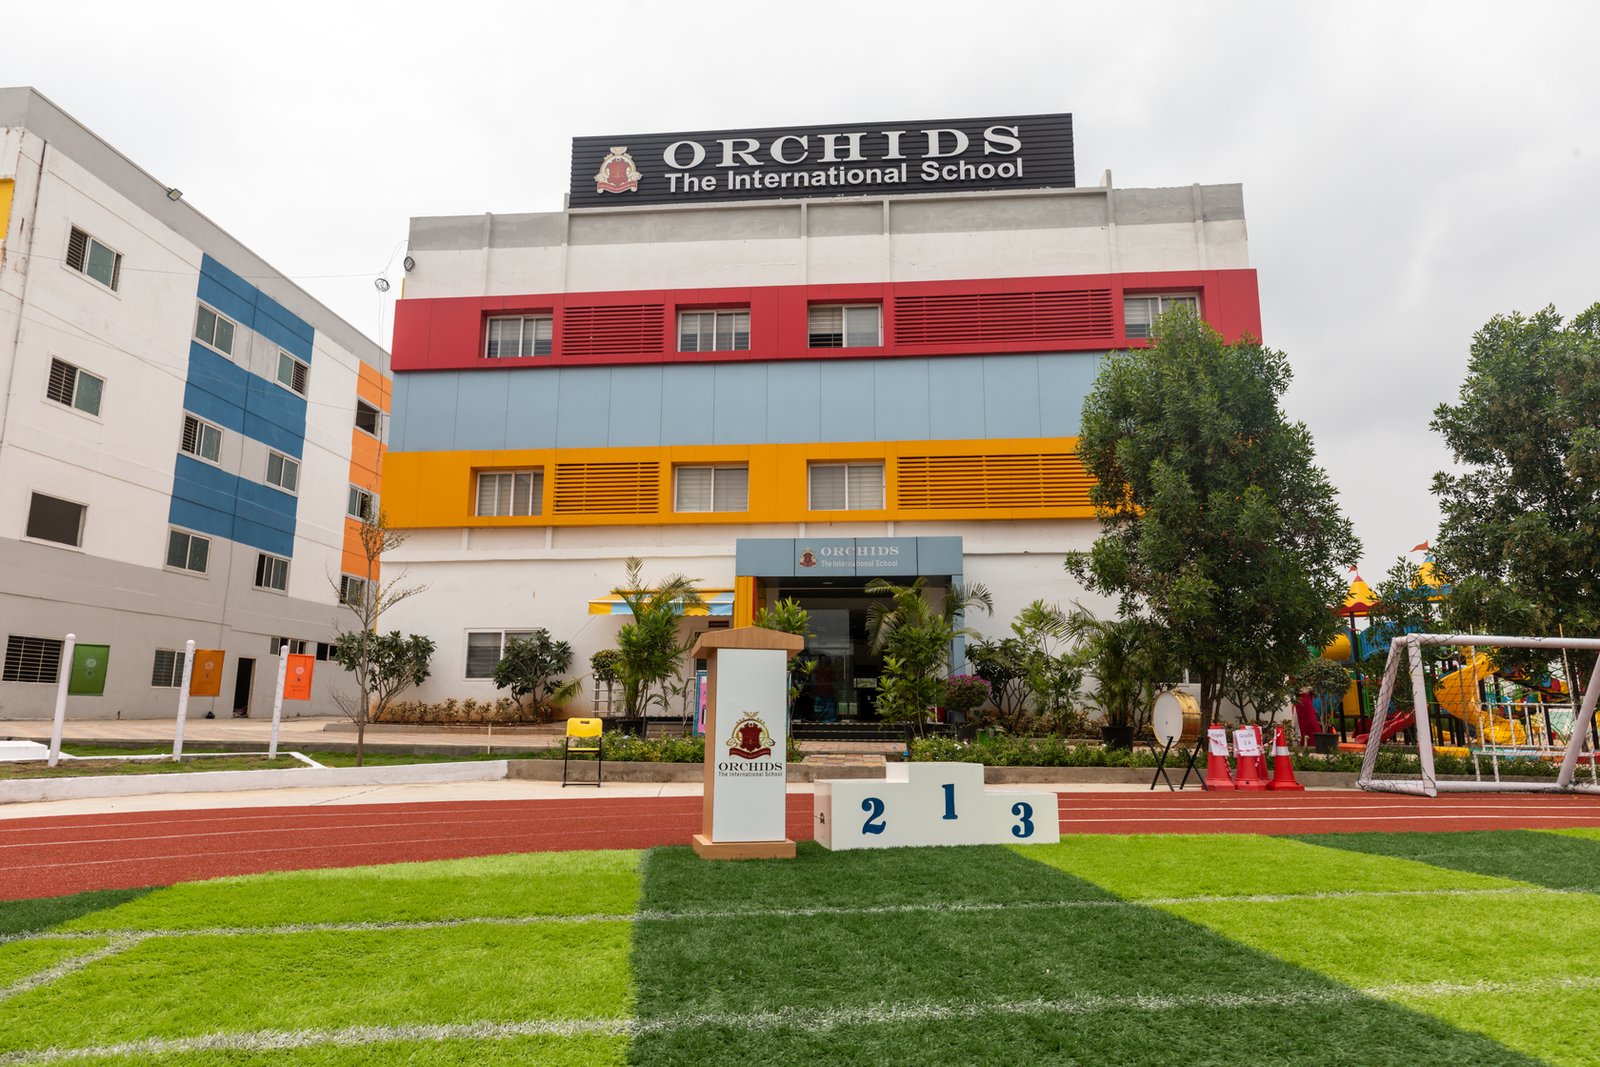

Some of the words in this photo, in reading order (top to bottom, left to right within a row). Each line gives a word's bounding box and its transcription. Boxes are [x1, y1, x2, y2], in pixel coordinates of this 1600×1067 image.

[662, 126, 1022, 170] ORCHIDS
[664, 172, 716, 193] The
[728, 162, 908, 190] International
[920, 158, 1023, 182] School
[820, 546, 899, 556] ORCHIDS
[718, 762, 782, 771] ORCHIDS
[861, 797, 886, 835] 2
[941, 783, 958, 820] 1
[1011, 802, 1034, 838] 3
